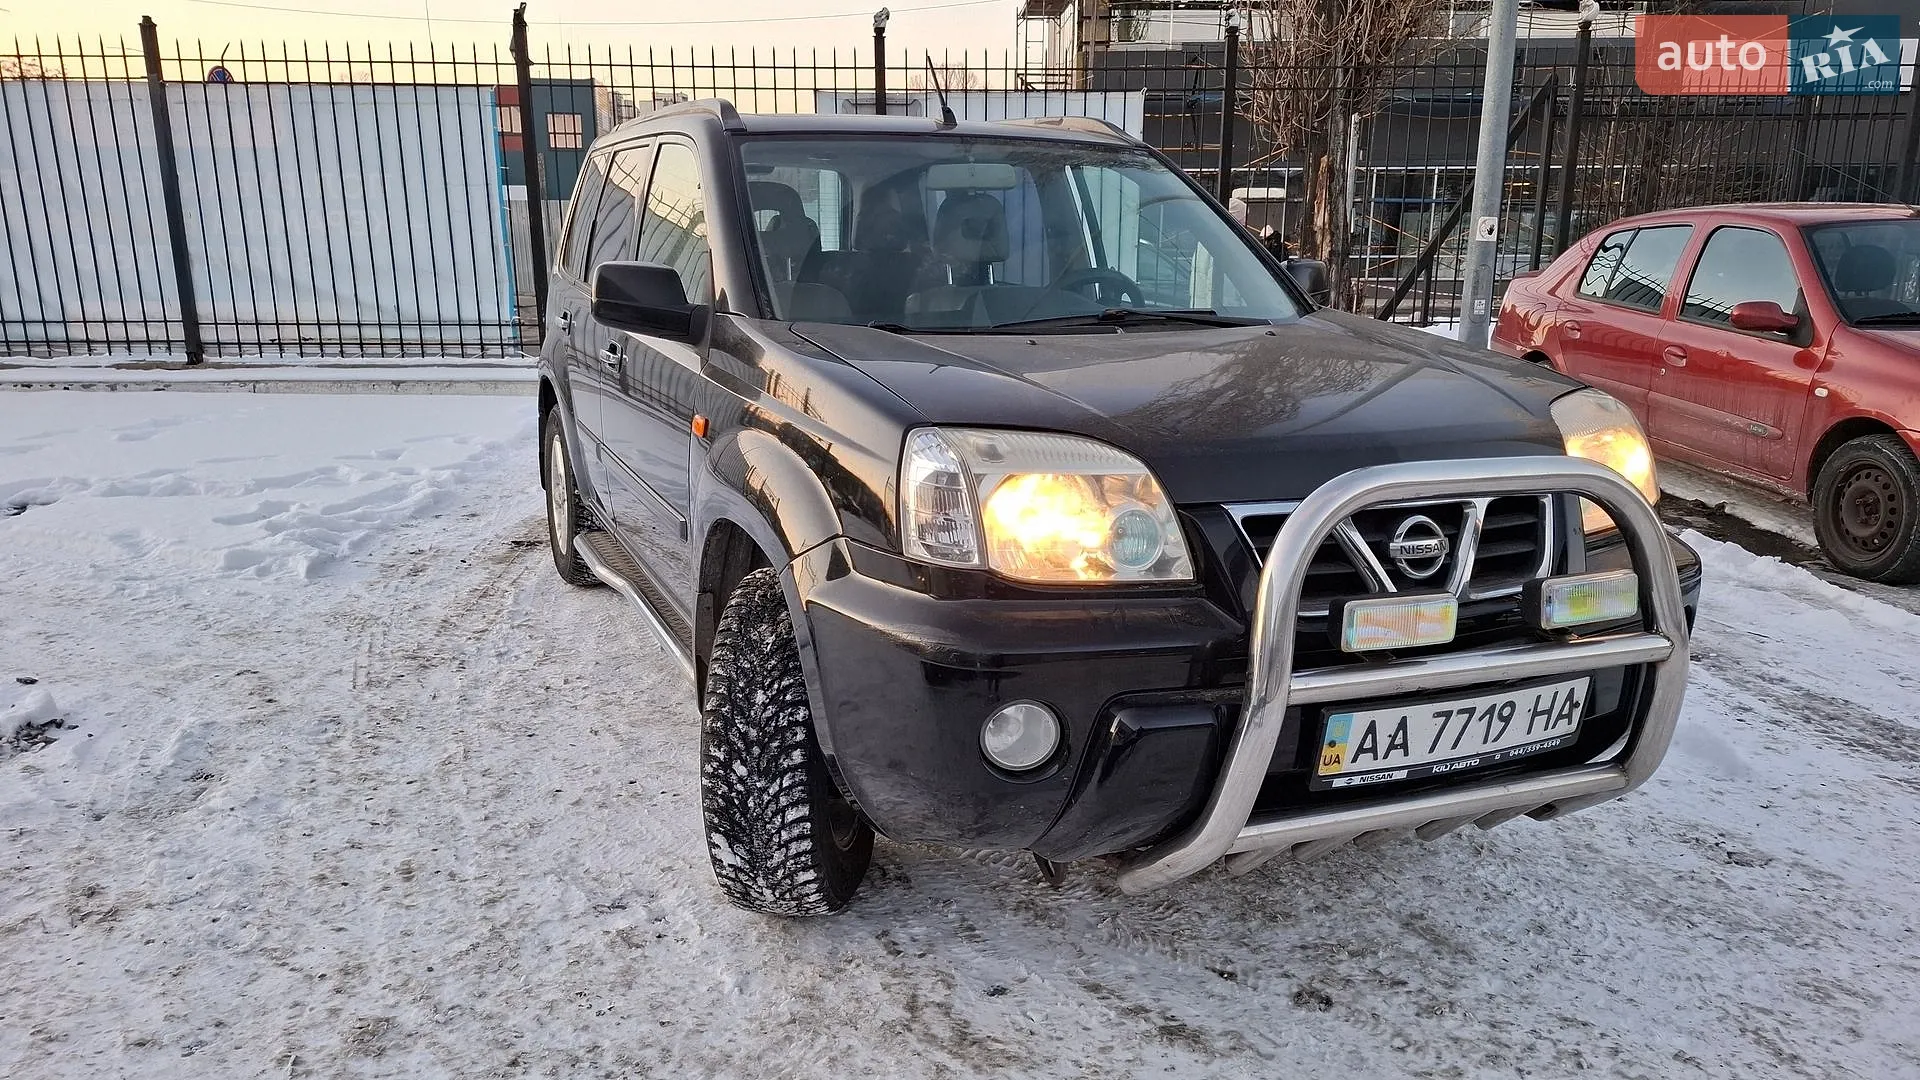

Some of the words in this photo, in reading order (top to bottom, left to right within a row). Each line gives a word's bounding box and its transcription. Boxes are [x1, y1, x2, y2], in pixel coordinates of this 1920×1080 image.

[1400, 540, 1447, 555] NISSAN
[1351, 715, 1409, 764] AA
[1427, 700, 1516, 754] 7719
[1526, 687, 1576, 735] HA
[1323, 754, 1341, 766] UA
[1359, 772, 1394, 783] NISSAN
